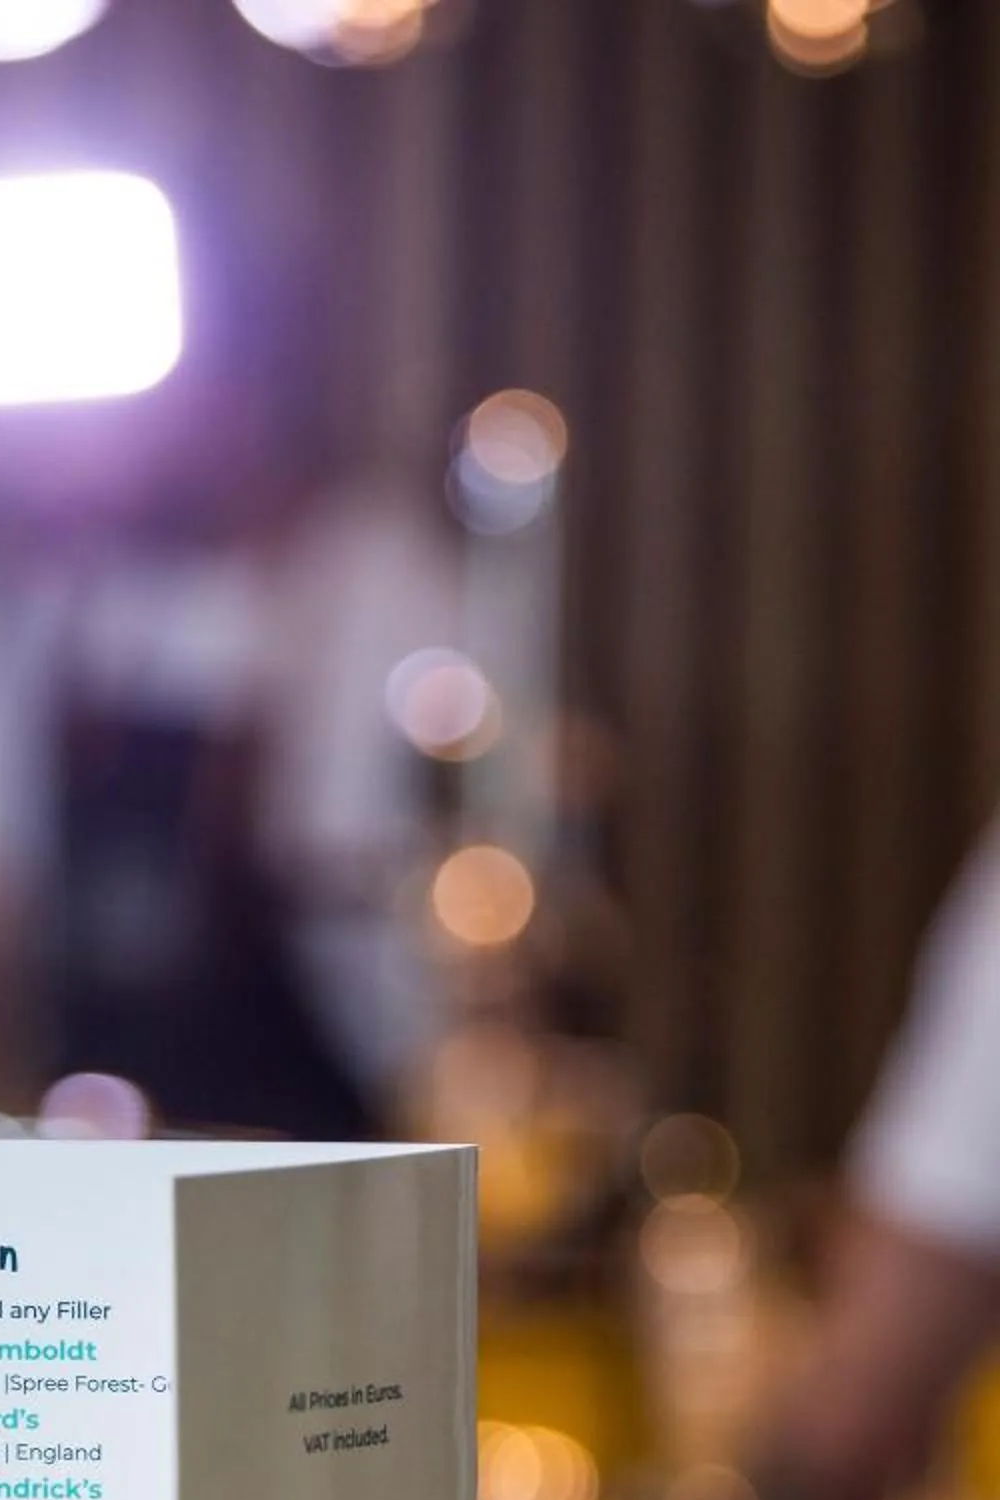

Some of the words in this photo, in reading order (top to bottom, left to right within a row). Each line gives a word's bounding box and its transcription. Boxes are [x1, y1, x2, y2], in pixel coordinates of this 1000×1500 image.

[8, 1302, 52, 1325] any
[56, 1299, 112, 1321] Filler
[309, 1390, 349, 1409] Prices
[350, 1384, 363, 1405] in
[303, 1432, 330, 1453] VAT
[14, 1442, 103, 1469] England
